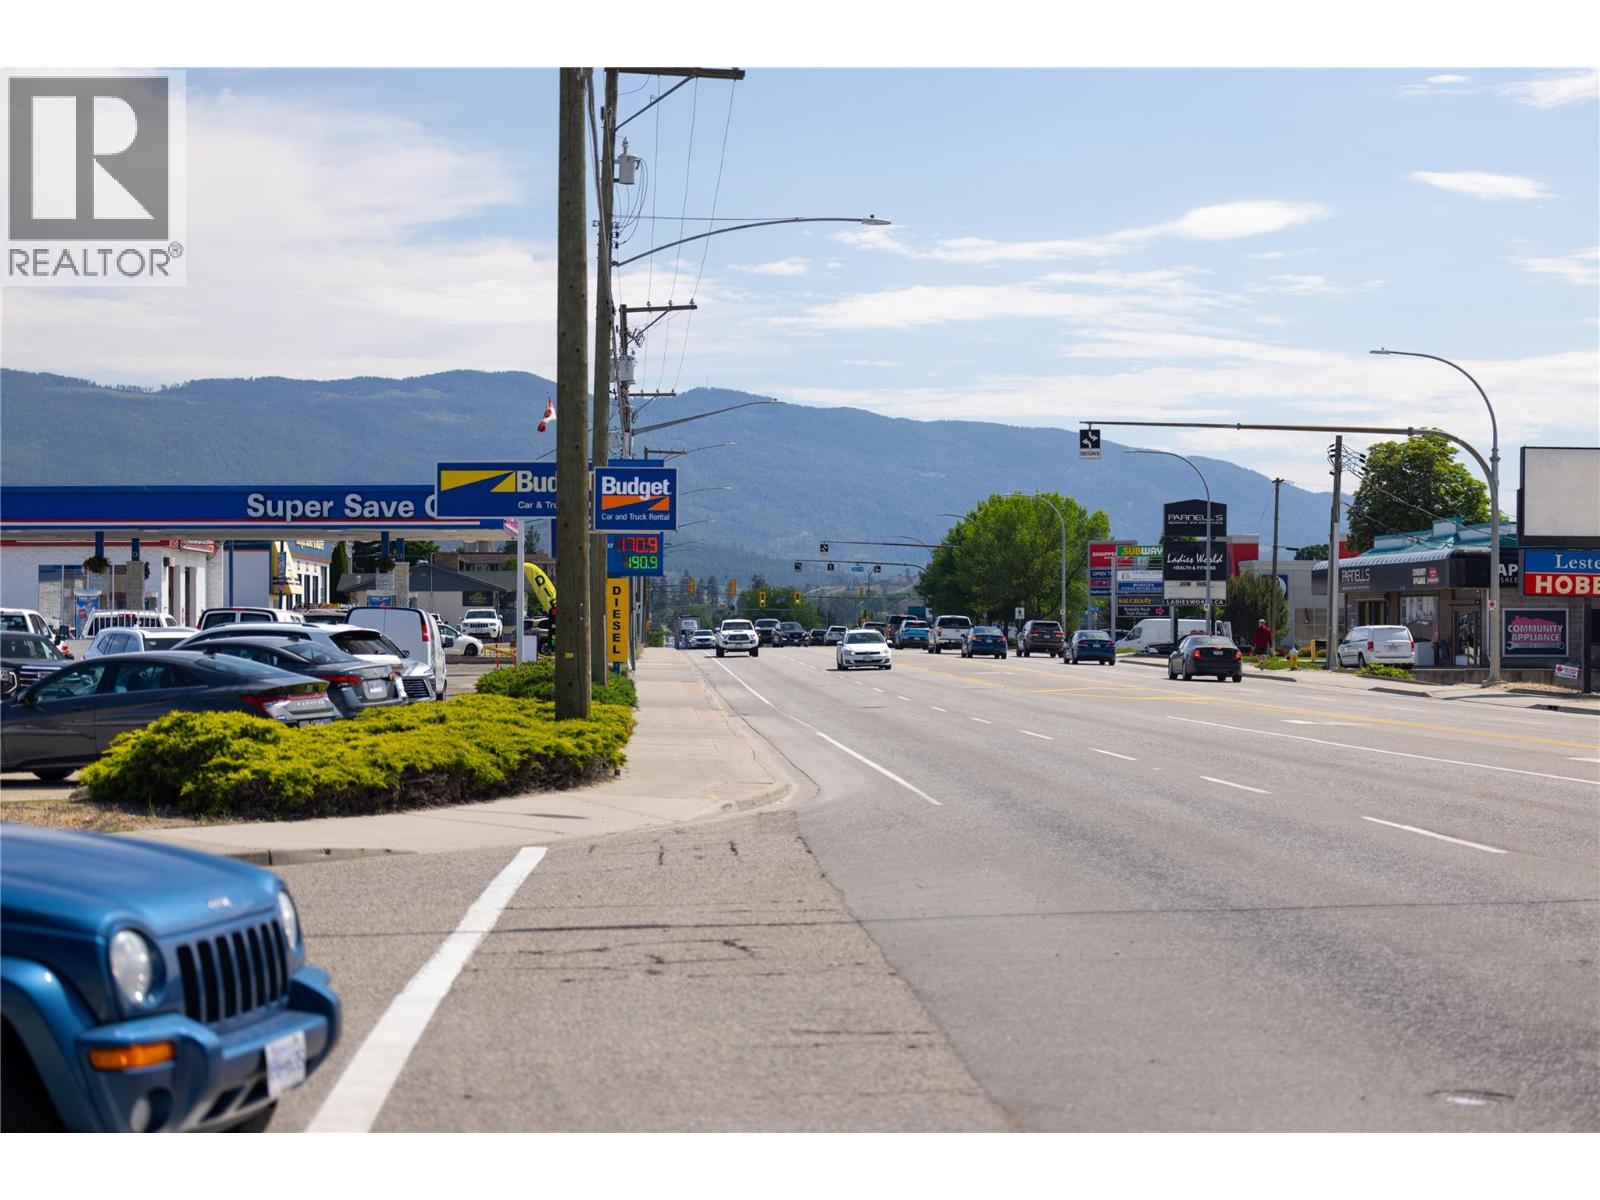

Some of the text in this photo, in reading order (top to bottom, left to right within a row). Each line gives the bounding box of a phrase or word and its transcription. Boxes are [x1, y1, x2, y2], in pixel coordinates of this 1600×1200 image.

[601, 476, 670, 501] Budget
[246, 493, 334, 523] Super
[344, 493, 415, 518] Save
[518, 501, 533, 510] Car
[535, 501, 543, 510] &
[601, 513, 670, 521] Car and Truck Rental
[621, 537, 658, 553] 170.9
[1122, 546, 1163, 556] SUBWAY
[628, 556, 658, 569] 190.9
[1166, 553, 1194, 564] Ladies
[612, 585, 621, 654] DIESEL
[1507, 625, 1564, 633] COMMUNITY
[1511, 633, 1560, 641] APPLIANCE
